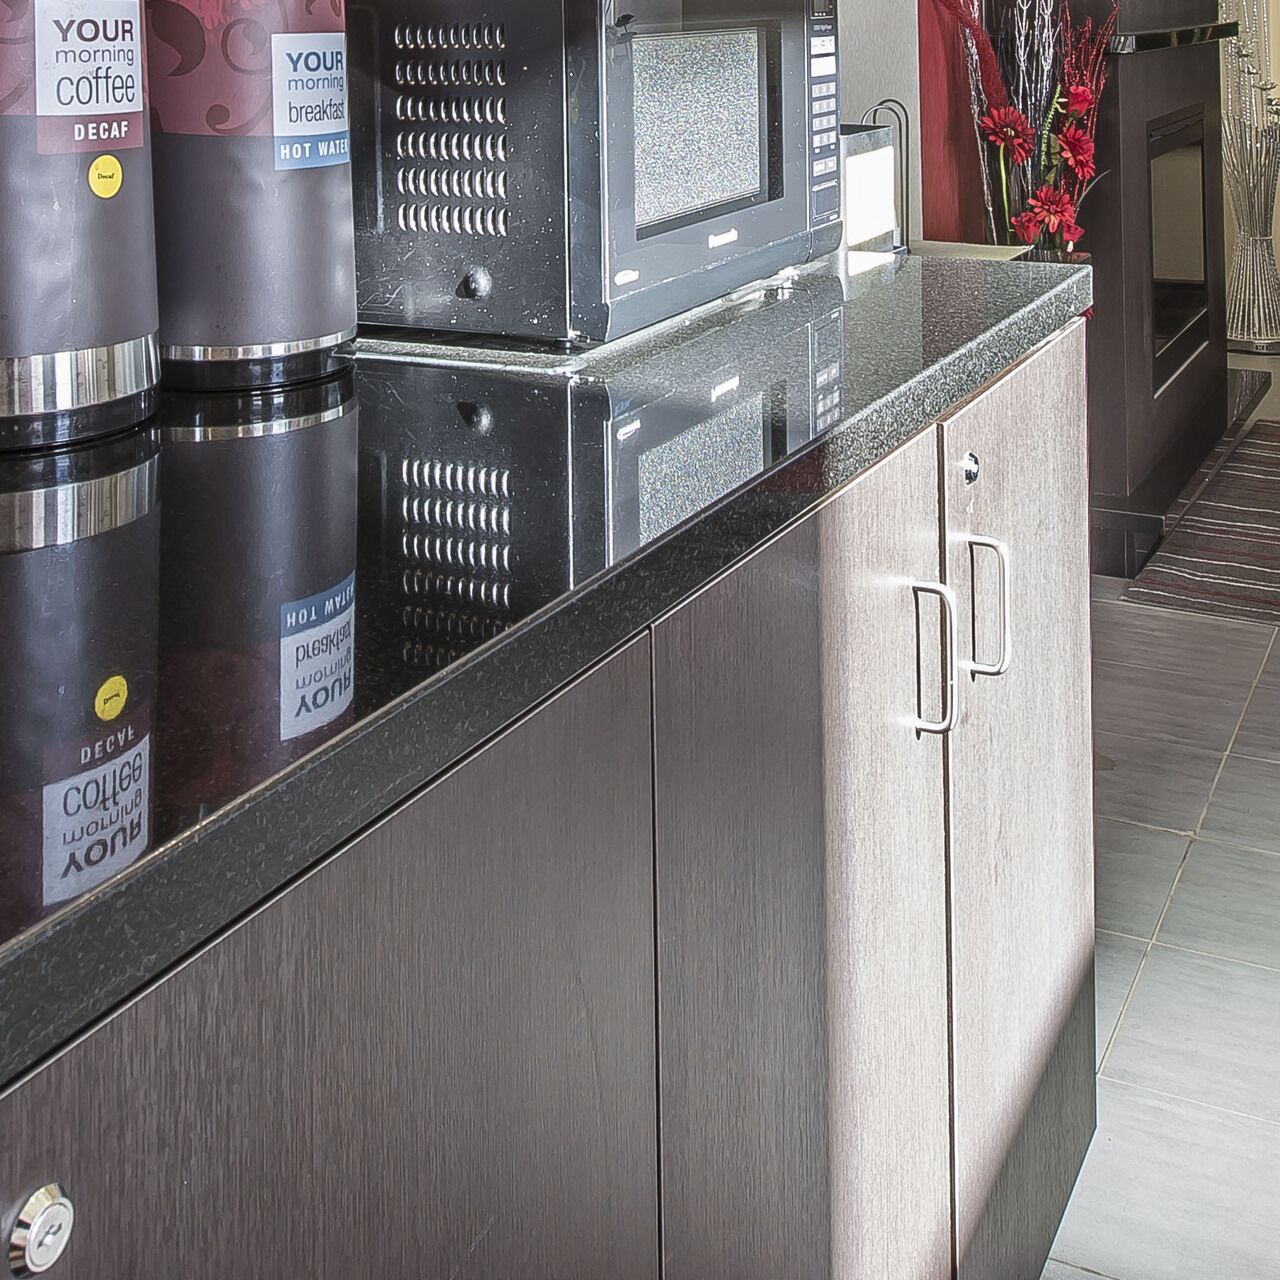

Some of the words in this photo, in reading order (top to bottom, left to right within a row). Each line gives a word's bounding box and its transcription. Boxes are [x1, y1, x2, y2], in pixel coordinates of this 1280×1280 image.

[52, 19, 134, 43] YOUR
[55, 44, 134, 66] morning
[286, 50, 344, 73] YOUR
[56, 66, 135, 106] coffee
[288, 73, 344, 92] morning
[288, 98, 345, 123] breakfast
[73, 120, 129, 141] DECAF
[280, 143, 312, 160] HOT
[97, 172, 115, 180] Decaf
